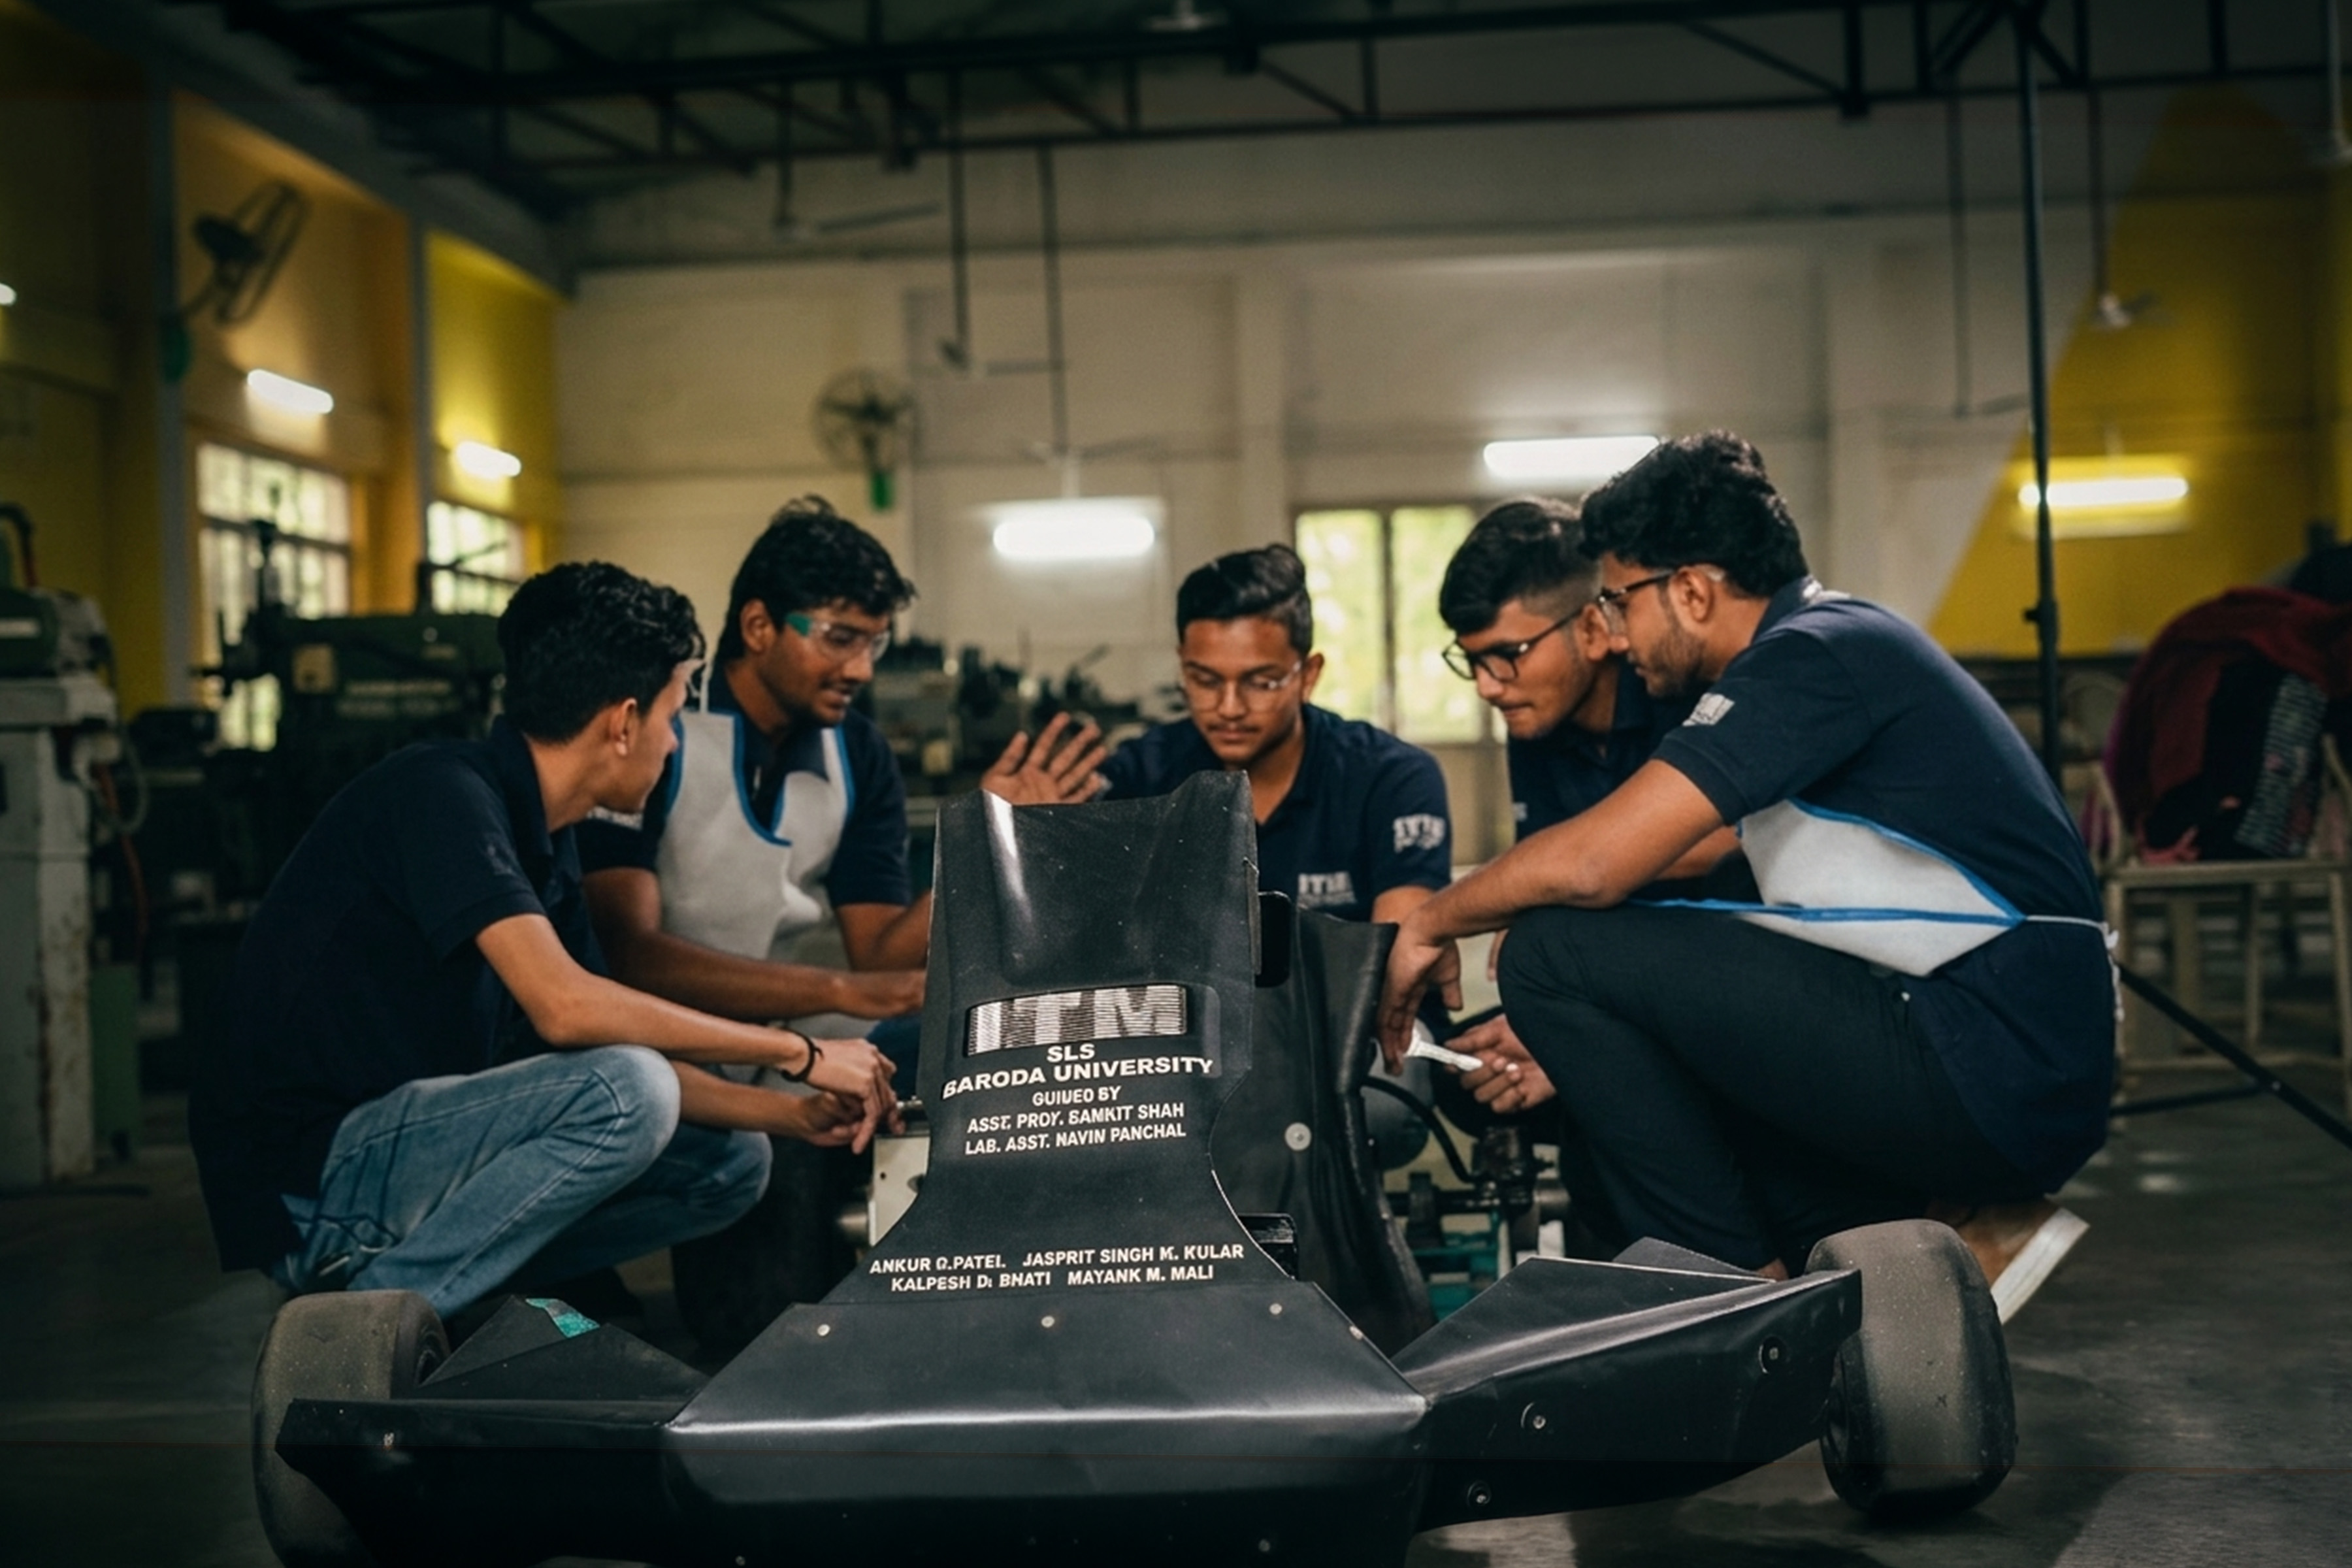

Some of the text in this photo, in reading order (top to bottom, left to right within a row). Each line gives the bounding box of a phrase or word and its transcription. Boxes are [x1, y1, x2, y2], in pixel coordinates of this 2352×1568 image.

[976, 985, 1180, 1054] ITM
[1046, 1043, 1095, 1063] SLS
[943, 1056, 1213, 1101] BARODA UNIVERSITY
[1137, 1102, 1184, 1120] SHAH
[965, 1122, 1186, 1155] LAB. ASST. NAVIN PANCHAL
[869, 1257, 931, 1274] ANKUR
[1022, 1249, 1096, 1267] JASPRIT
[1100, 1247, 1154, 1264] SINGH
[1184, 1243, 1244, 1260] KULAR
[891, 1275, 971, 1292] KALPESH
[1067, 1267, 1141, 1285] MAYANK
[1146, 1267, 1166, 1282] M.
[1170, 1264, 1213, 1281] MALI
